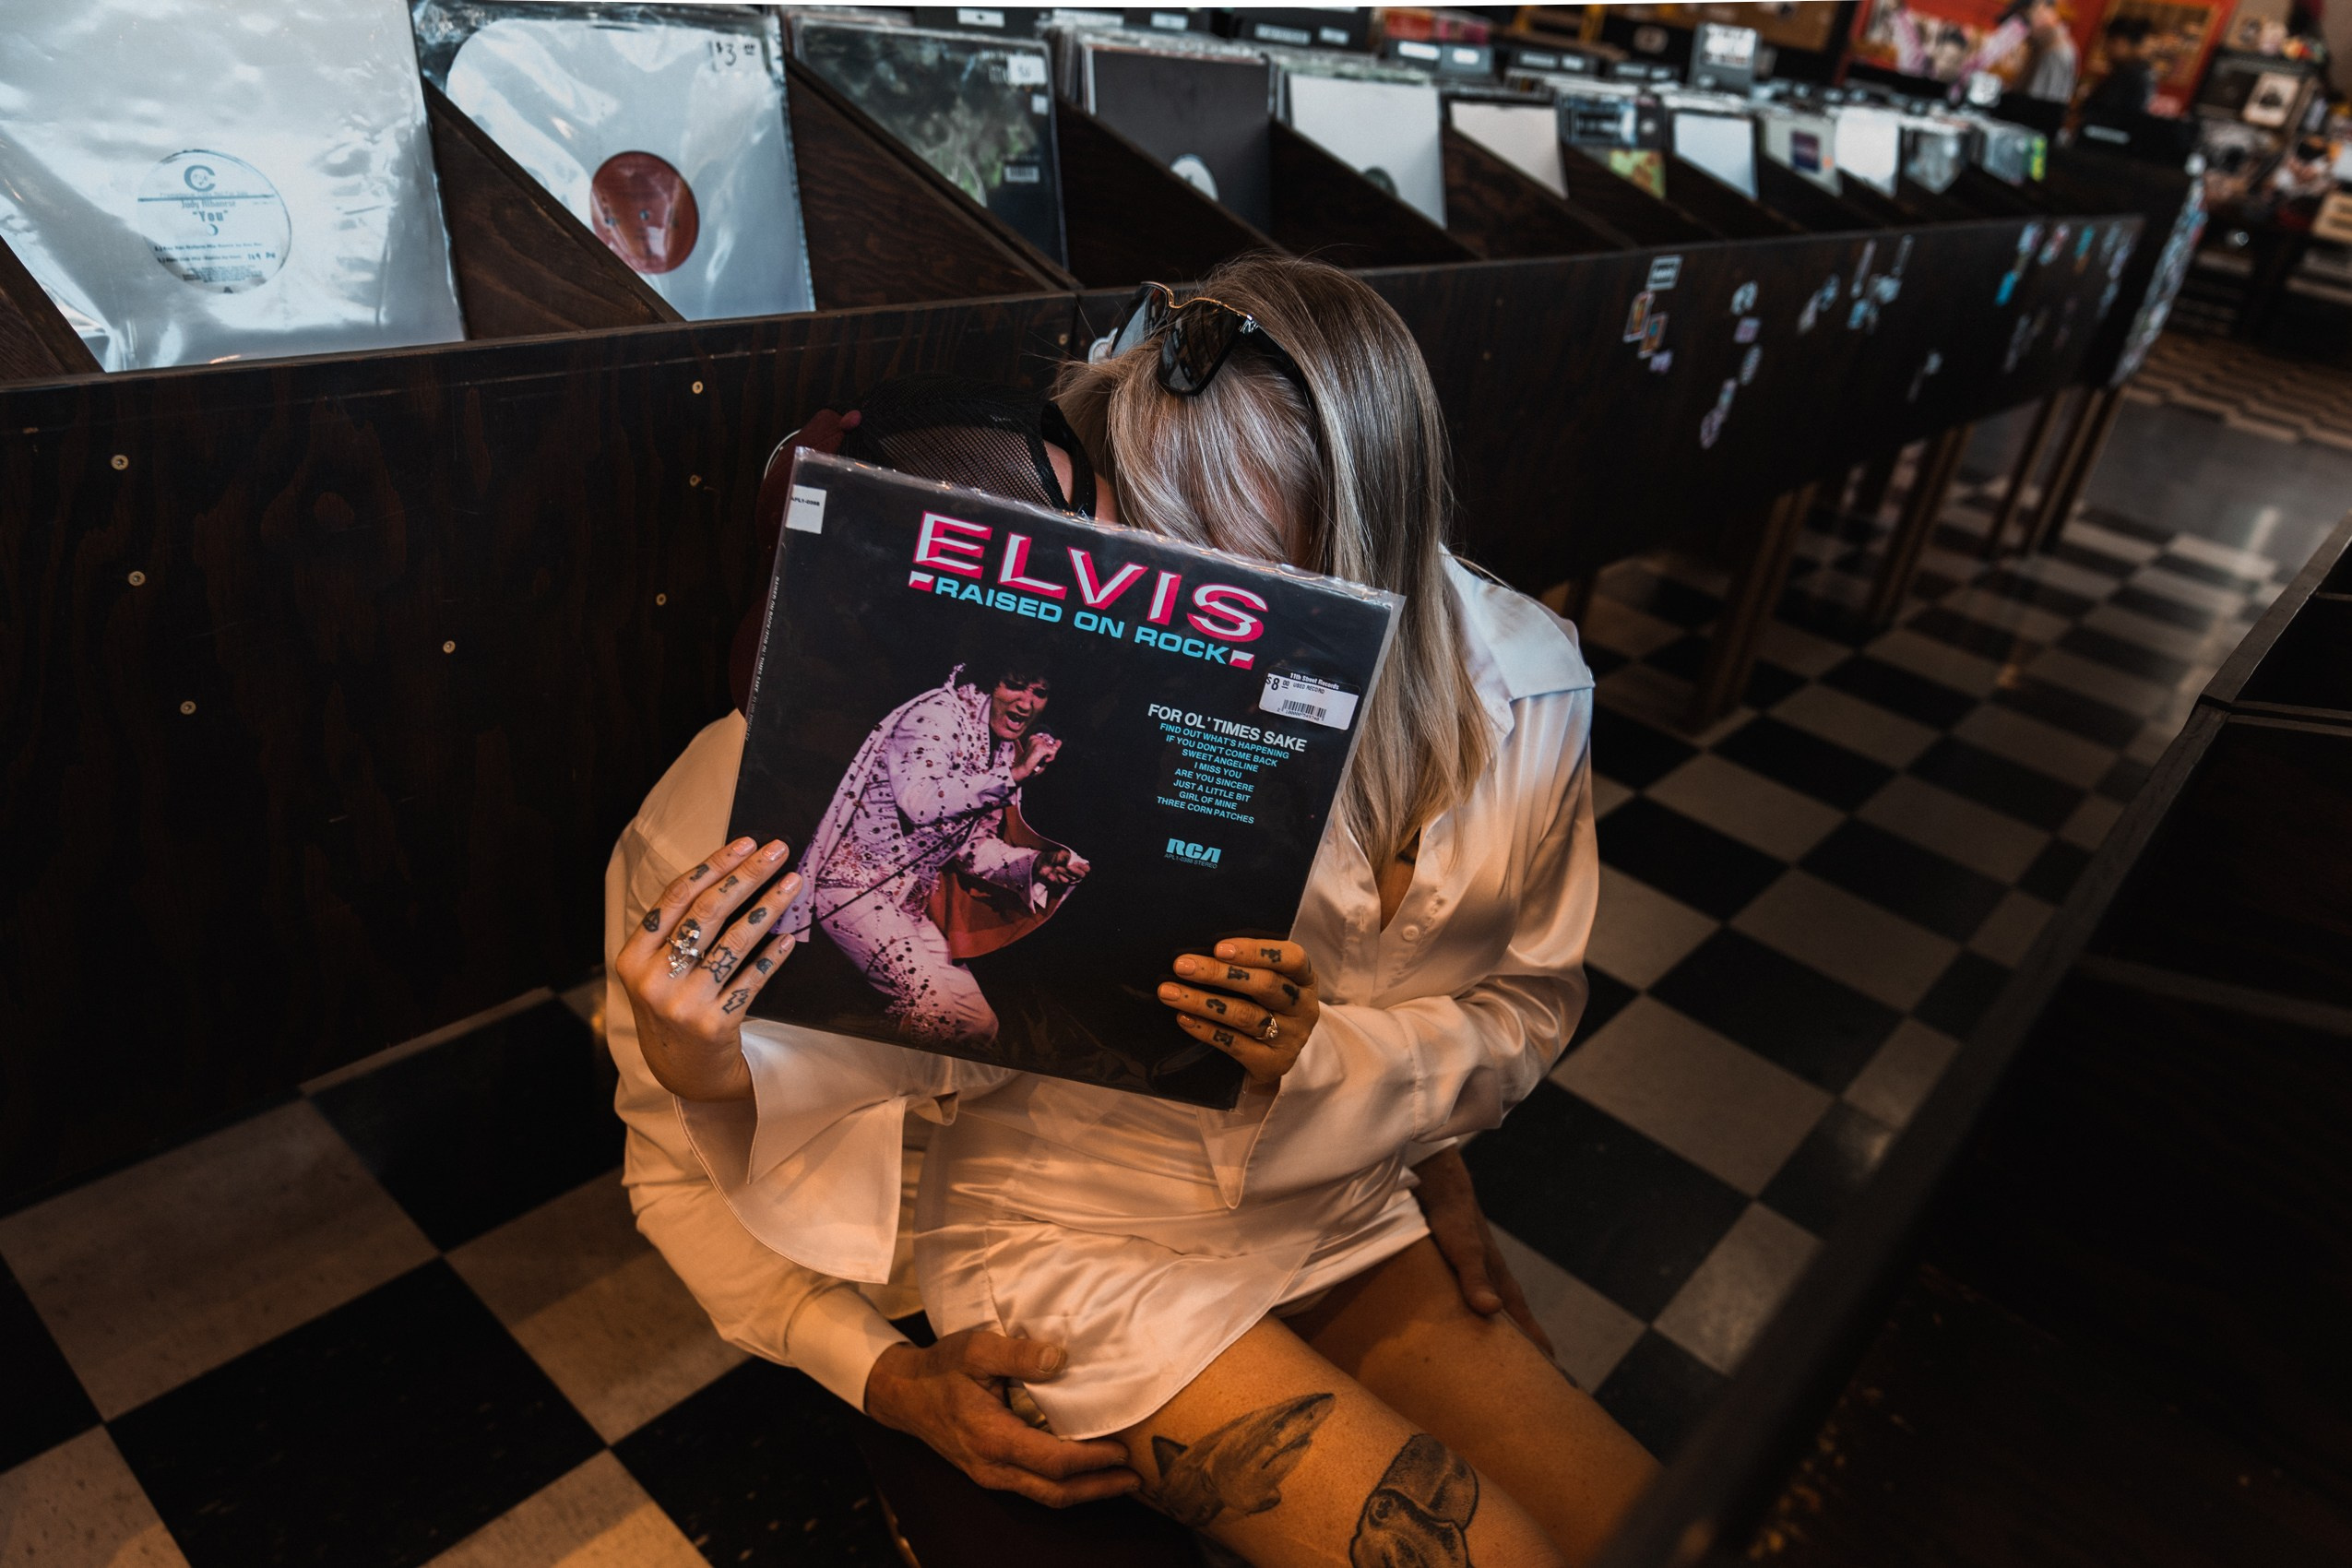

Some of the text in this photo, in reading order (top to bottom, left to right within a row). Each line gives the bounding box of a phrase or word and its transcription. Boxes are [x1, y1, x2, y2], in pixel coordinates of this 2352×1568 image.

[912, 510, 1269, 643] ELVIS
[935, 576, 1231, 665] RAISED ON ROCK
[1290, 672, 1340, 690] 11th Street Records
[1306, 684, 1325, 695] RECORD
[1147, 703, 1183, 723] FOR
[1213, 718, 1261, 742] TIMES
[1263, 731, 1308, 753] SAKE
[1159, 722, 1182, 734] FIND
[1182, 728, 1203, 739] OUT
[1237, 741, 1289, 759] HAPPENING
[1166, 734, 1176, 742] IF
[1176, 736, 1196, 748] YOU
[1224, 748, 1253, 761] COME
[1253, 754, 1277, 767] BACK
[1182, 748, 1259, 773] SWEET ANGELINE
[1174, 768, 1254, 792] ARE YOU SINCERE
[1198, 762, 1221, 775] MISS
[1223, 767, 1242, 779] YOU
[1173, 778, 1251, 802] JUST A LITTLE BIT
[1179, 790, 1238, 810] GIRL OF MINE
[1157, 796, 1254, 824] THREE CORN PATCHES
[1166, 838, 1222, 863] RCA
[1194, 860, 1218, 870] STEREO
